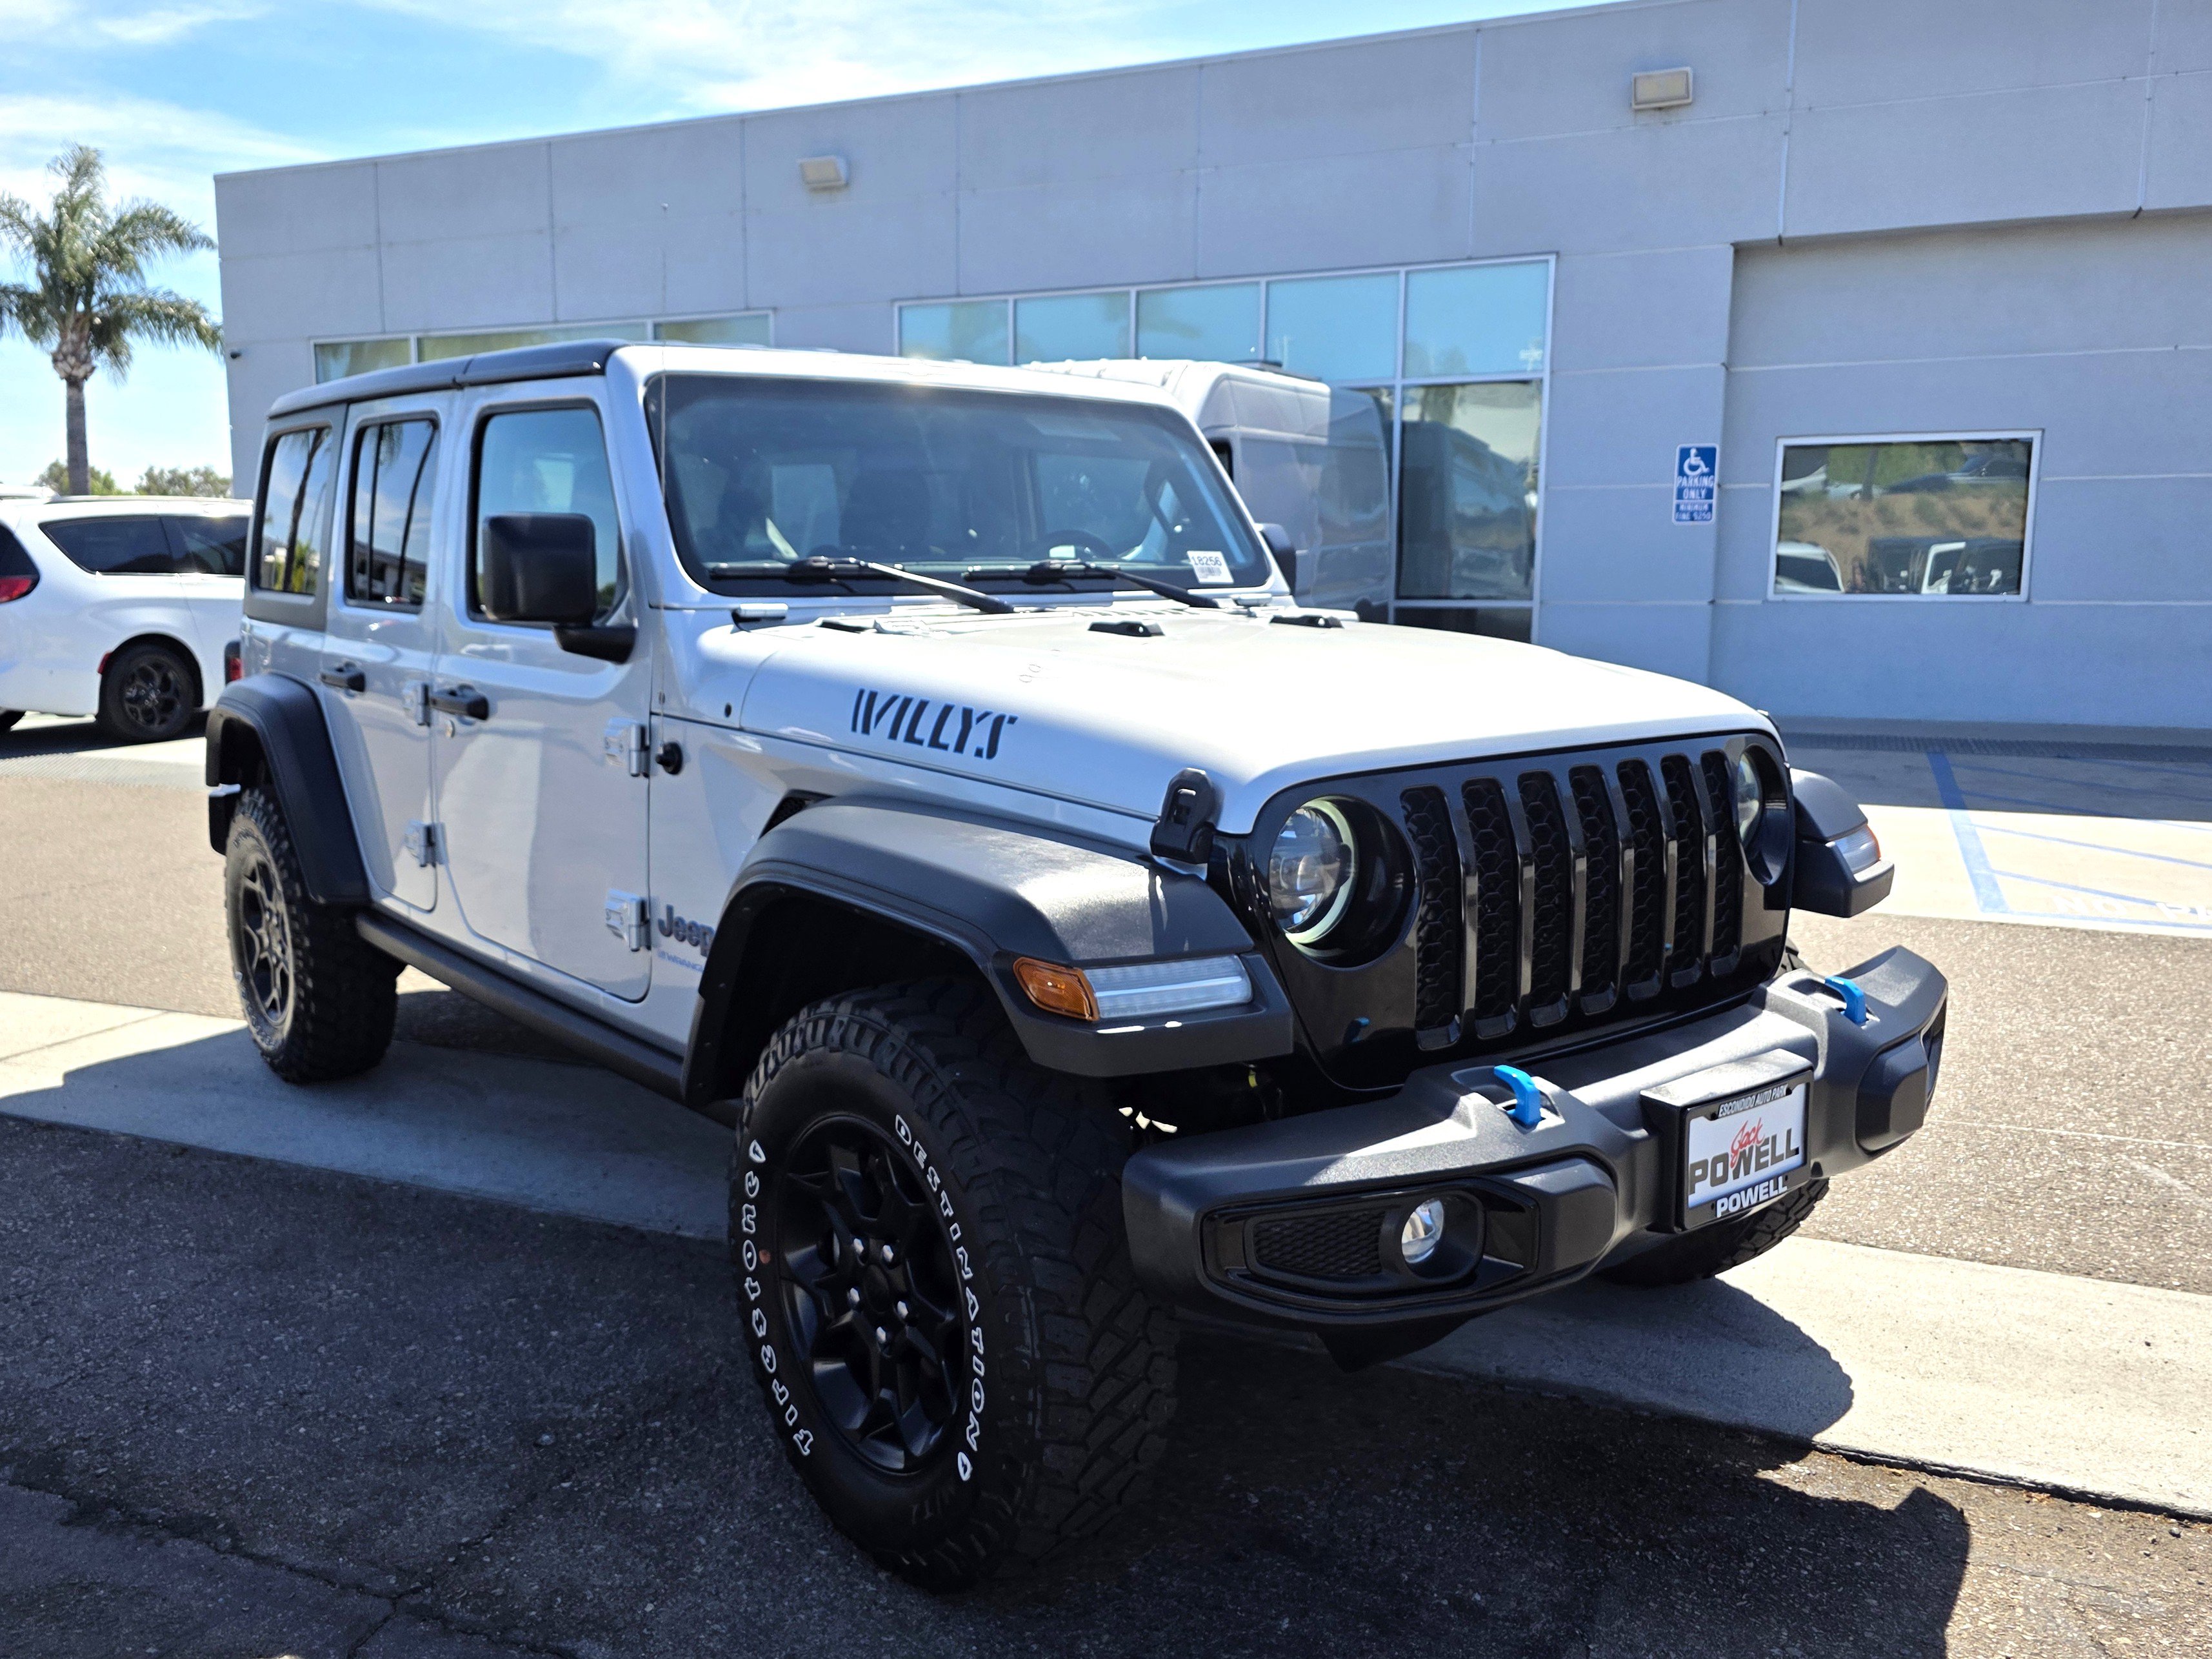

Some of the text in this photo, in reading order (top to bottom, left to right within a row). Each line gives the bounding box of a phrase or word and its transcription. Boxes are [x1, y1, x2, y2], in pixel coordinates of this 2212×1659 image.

[1677, 476, 1715, 487] PARKING
[1682, 488, 1708, 499] ONLY
[1191, 556, 1222, 566] 18256
[850, 688, 1019, 759] WILLYS
[658, 904, 715, 957] Jeep
[1718, 1083, 1788, 1117] ESCONDIDO AUTO PARK
[1689, 1128, 1799, 1194] POWELL
[1730, 1118, 1764, 1169] Jack
[1716, 1176, 1788, 1218] POWELL
[895, 1114, 986, 1452] DESTINATION
